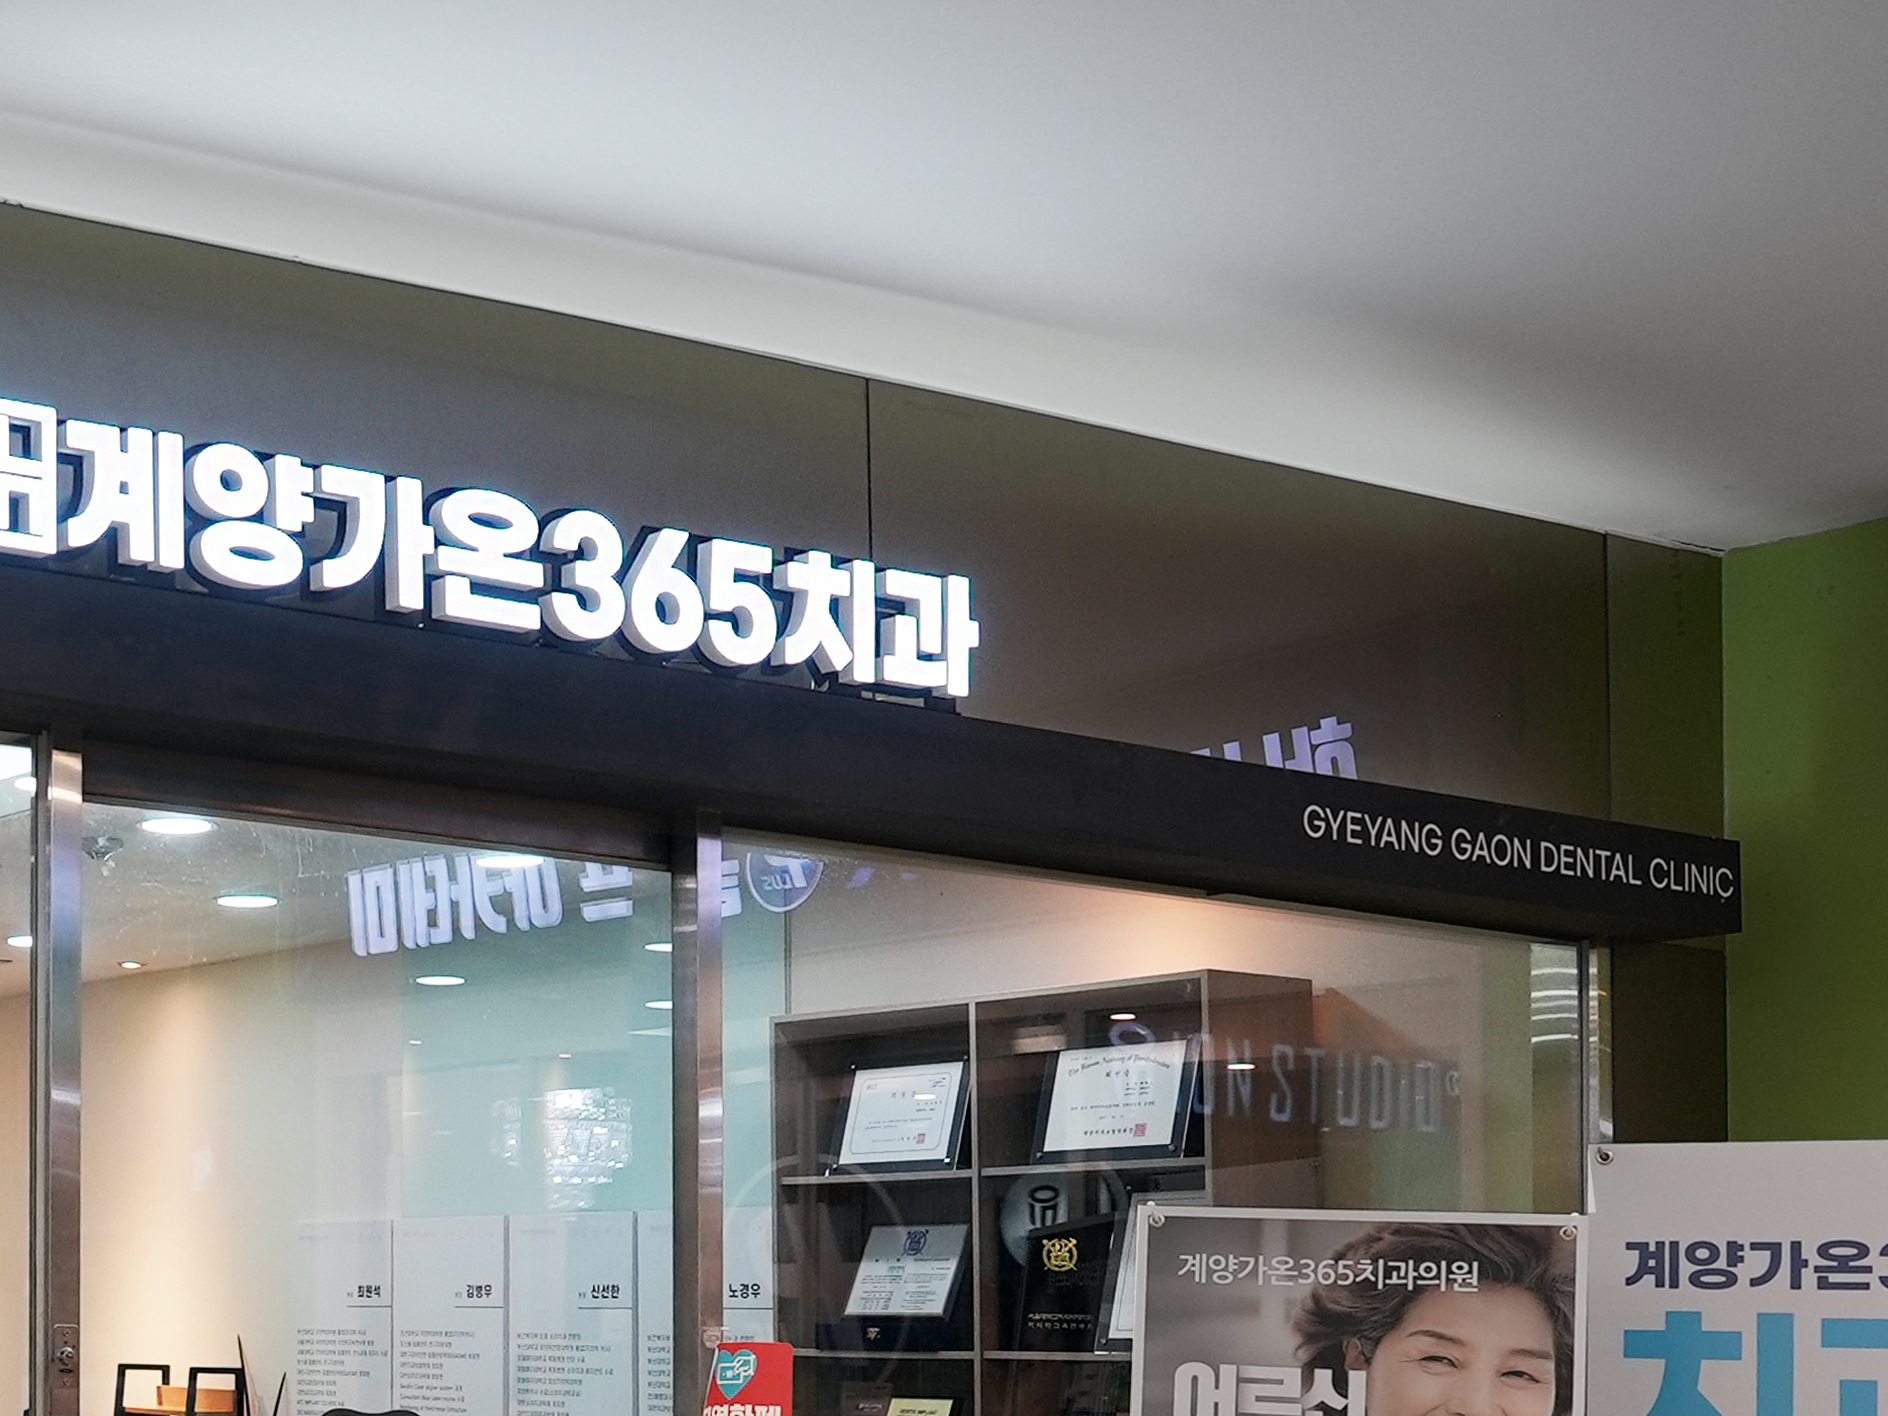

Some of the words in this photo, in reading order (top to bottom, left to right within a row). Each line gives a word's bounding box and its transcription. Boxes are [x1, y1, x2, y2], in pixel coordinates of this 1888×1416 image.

[62, 417, 980, 699] 계양가온365치과
[1303, 805, 1443, 857] GYEYANG
[1451, 828, 1532, 870] GAON
[1539, 839, 1642, 887] DENTAL
[1649, 858, 1734, 899] CLINIC
[1178, 1252, 1480, 1293] 계양가온365치과의원
[1624, 1239, 1888, 1290] 계양가온
